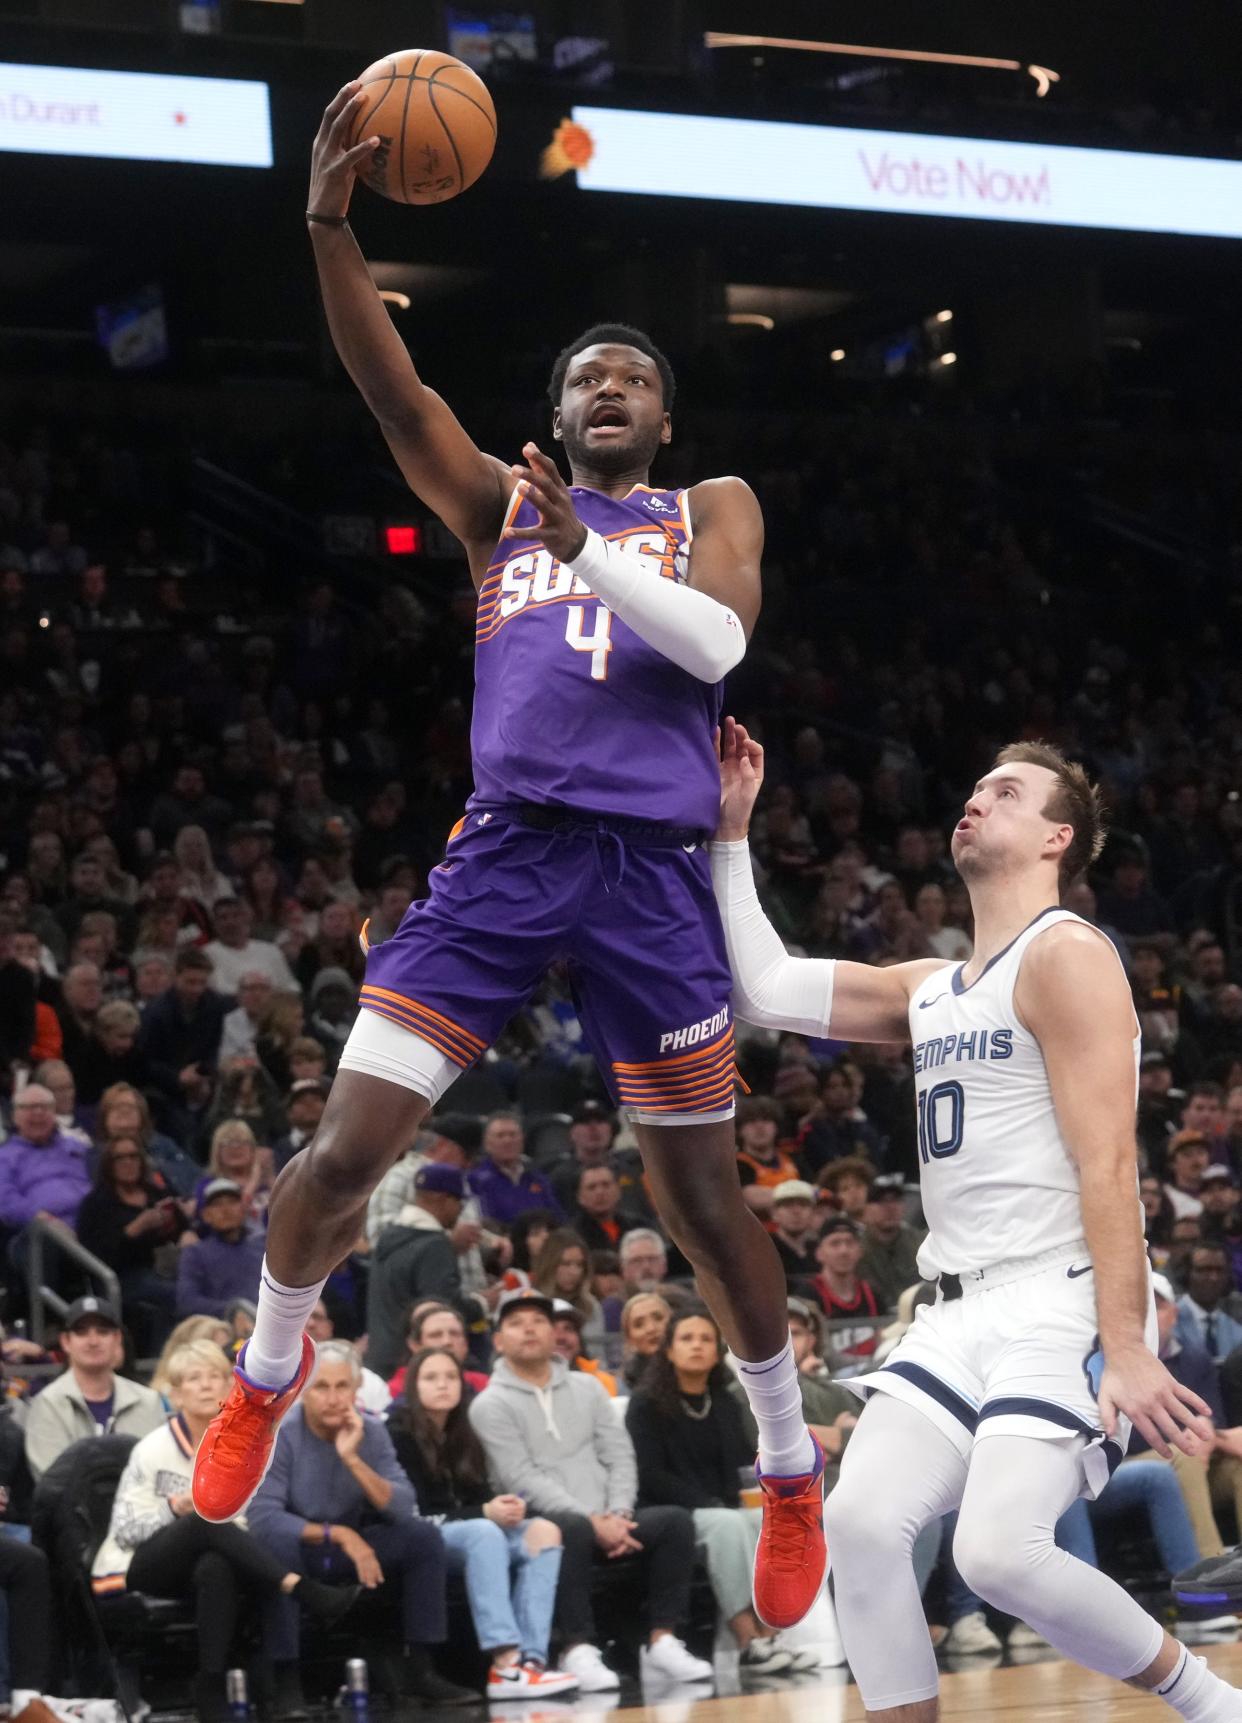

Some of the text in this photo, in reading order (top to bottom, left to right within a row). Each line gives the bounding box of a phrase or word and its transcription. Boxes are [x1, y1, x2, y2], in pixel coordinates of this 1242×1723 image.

[857, 149, 1050, 205] Vote Now!
[565, 605, 612, 681] 4
[659, 1003, 729, 1053] PHOENIX
[913, 1029, 1013, 1074] EMPHIS
[918, 1079, 965, 1164] 10
